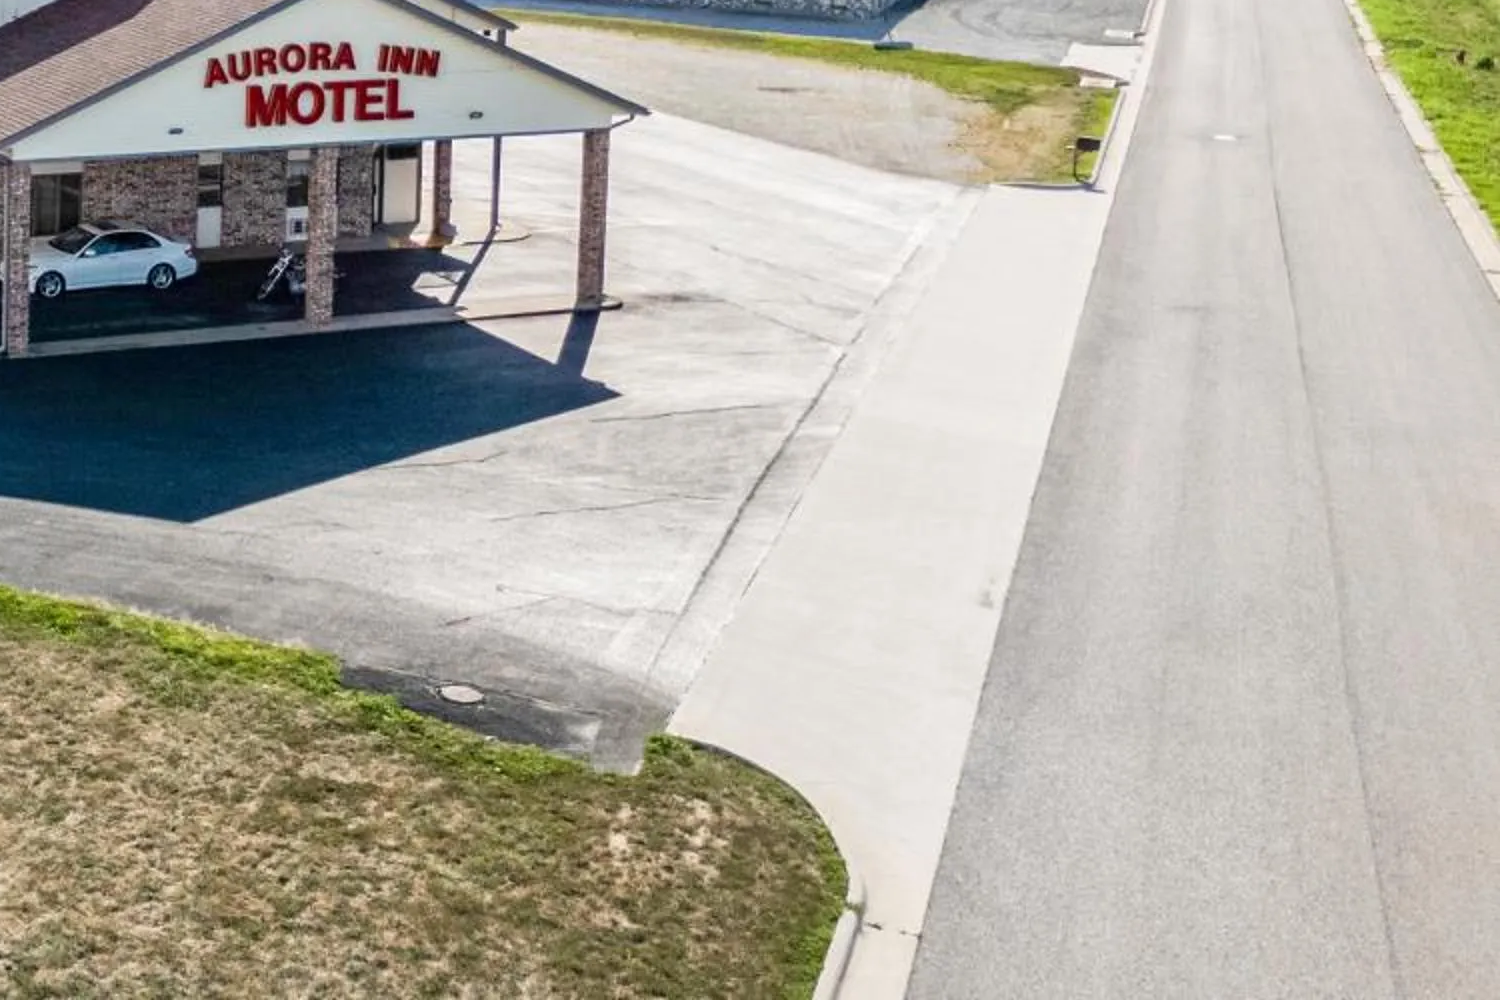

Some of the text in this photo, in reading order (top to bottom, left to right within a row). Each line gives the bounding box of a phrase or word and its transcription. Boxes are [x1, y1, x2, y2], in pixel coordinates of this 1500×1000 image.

[204, 42, 440, 88] AURORA INN
[245, 79, 414, 128] MOTEL
